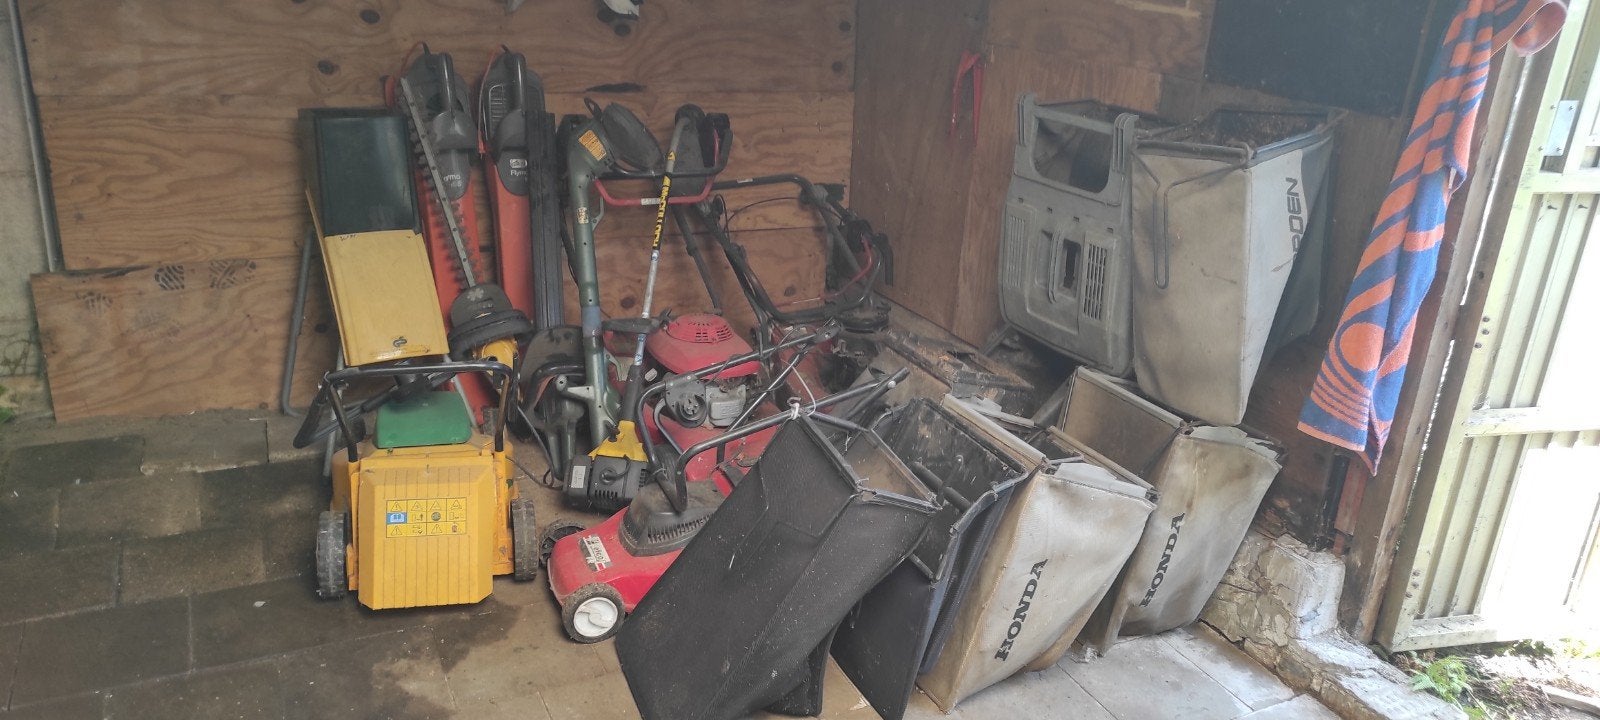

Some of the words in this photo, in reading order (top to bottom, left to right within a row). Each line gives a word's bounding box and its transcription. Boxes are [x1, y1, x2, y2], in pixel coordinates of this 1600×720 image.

[510, 169, 527, 177] Flym
[1285, 177, 1304, 257] RDEN
[1139, 512, 1185, 608] HONDA
[994, 558, 1048, 662] HONDA
